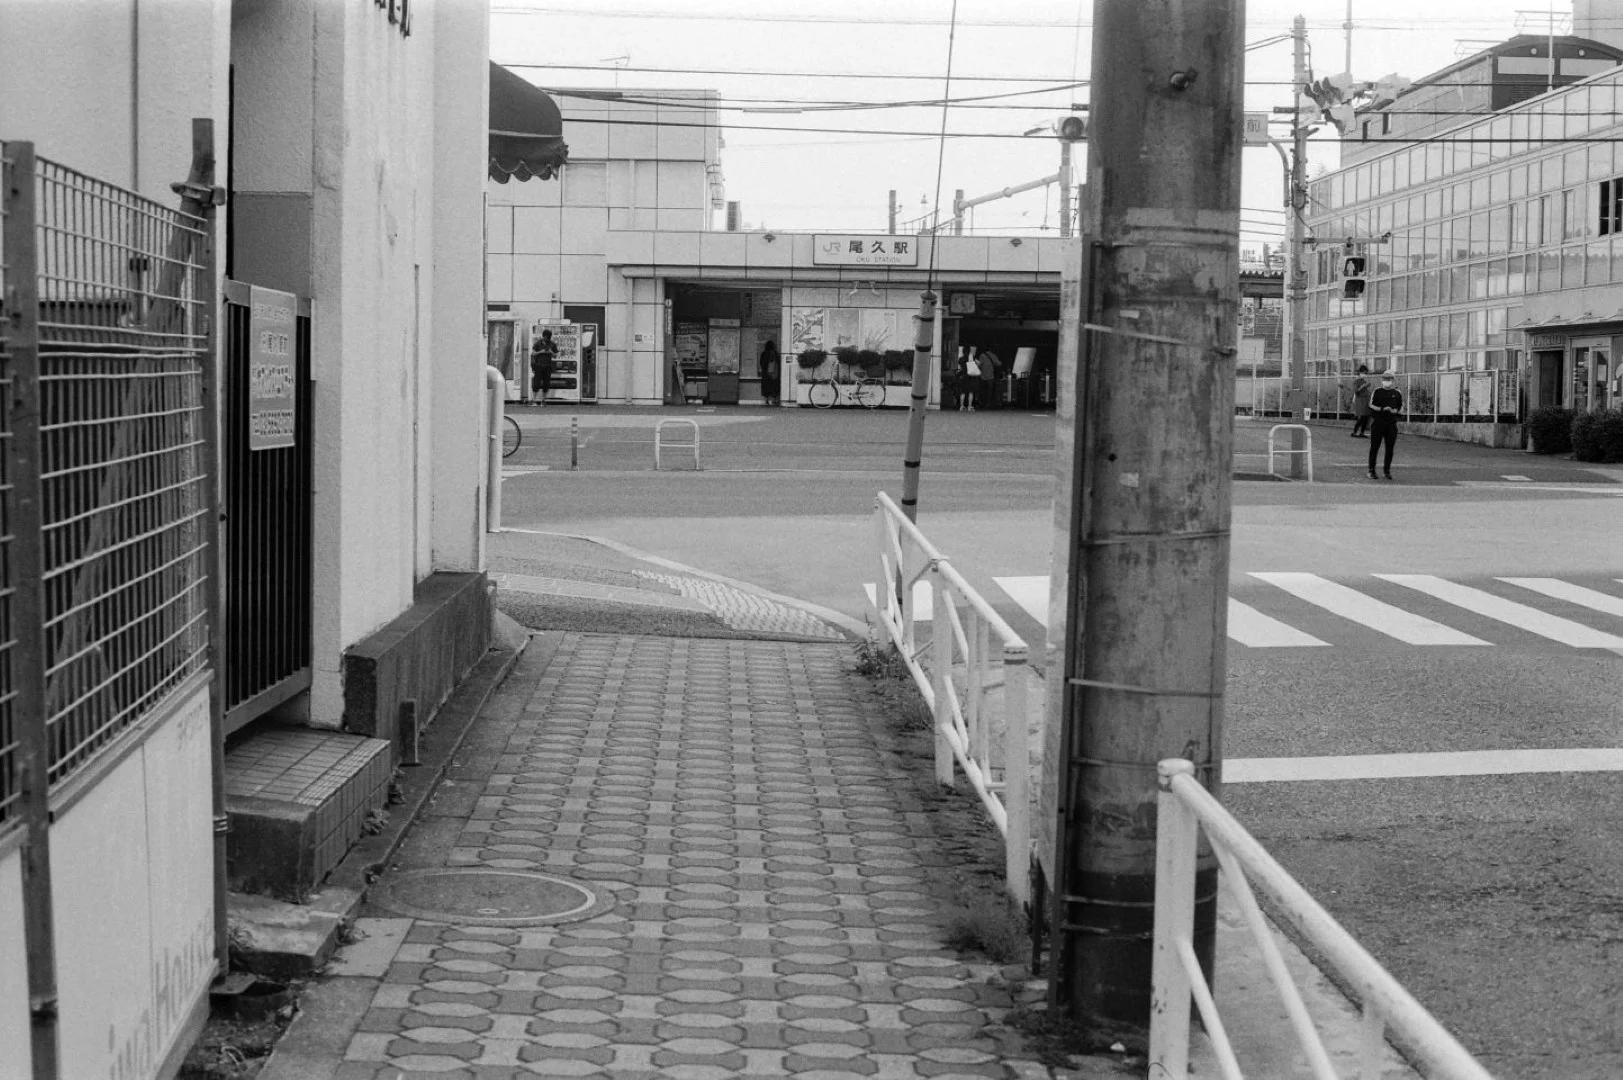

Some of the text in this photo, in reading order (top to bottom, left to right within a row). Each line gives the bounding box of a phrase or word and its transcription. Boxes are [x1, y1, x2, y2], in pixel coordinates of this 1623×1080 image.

[823, 240, 908, 254] JR 尾久駅
